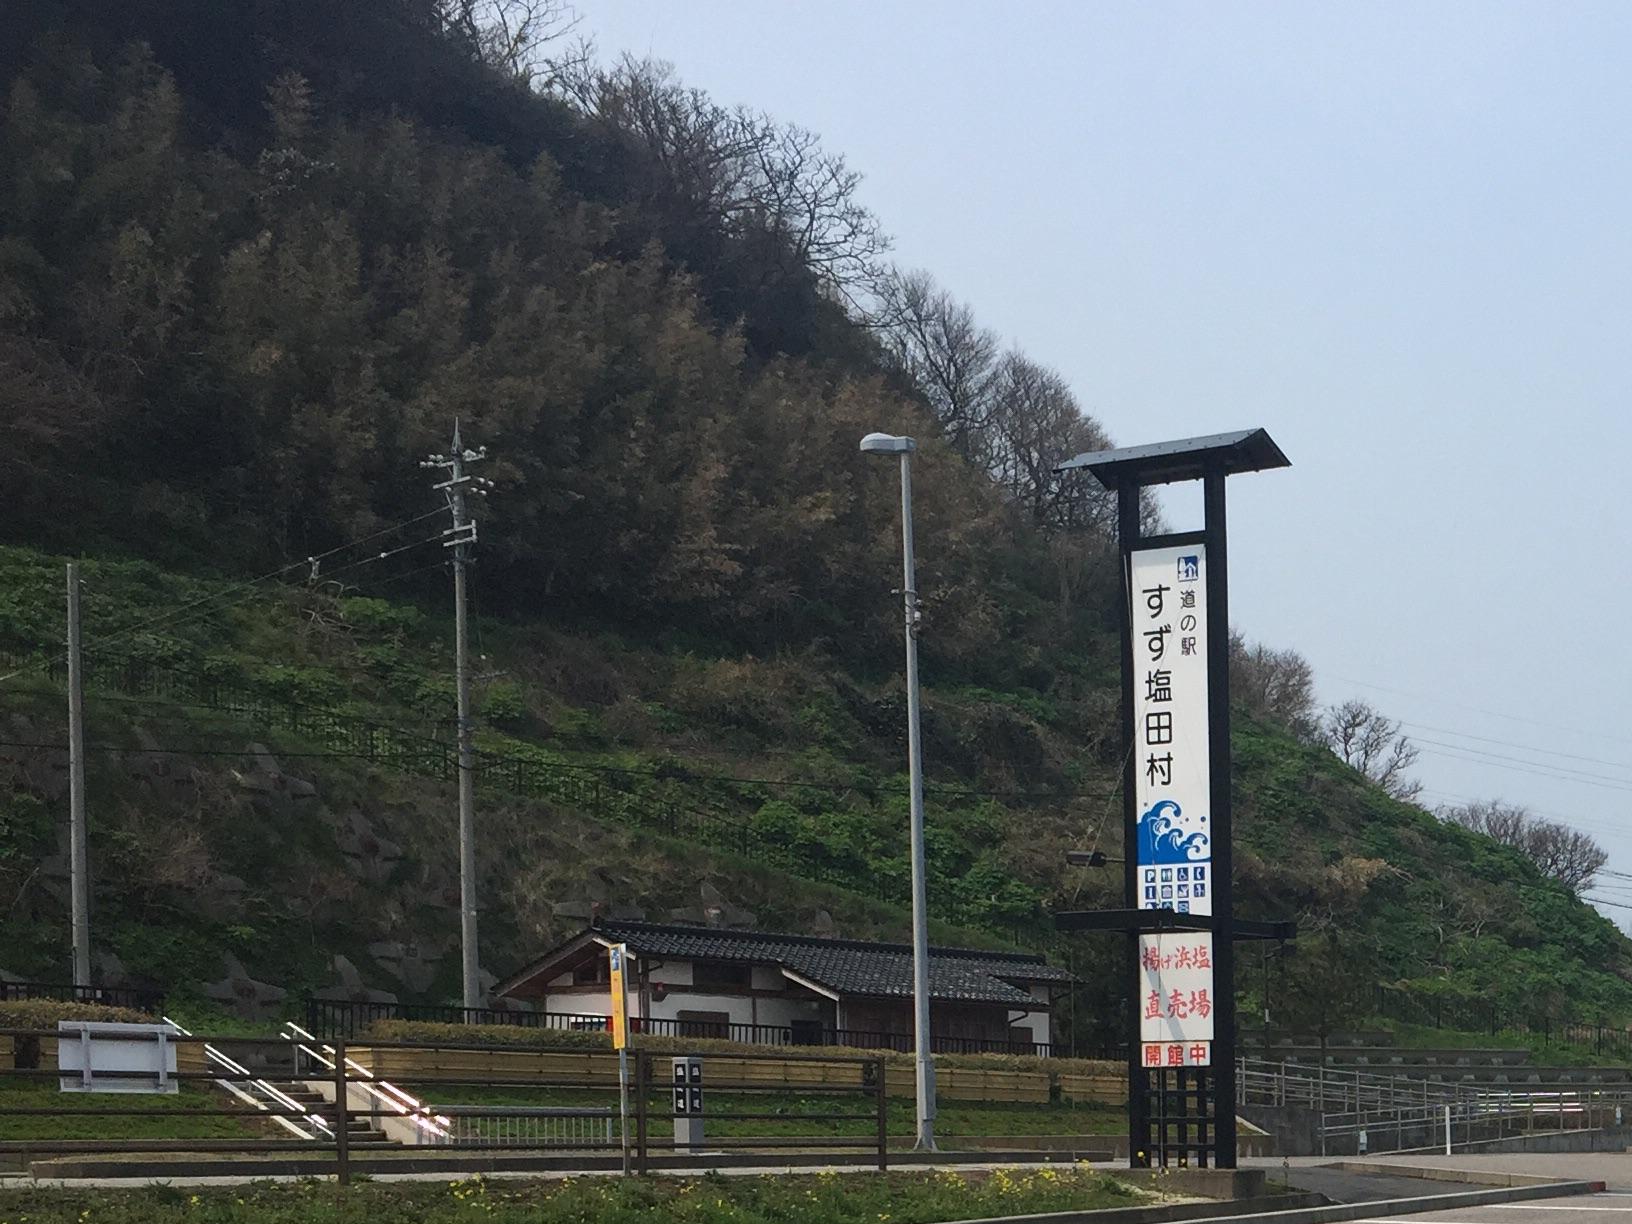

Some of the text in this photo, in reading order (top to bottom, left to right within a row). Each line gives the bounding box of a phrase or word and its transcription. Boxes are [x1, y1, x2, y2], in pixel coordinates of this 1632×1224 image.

[1180, 590, 1197, 656] 道の駅
[1142, 584, 1174, 787] すず塩田村
[1142, 946, 1211, 971] 揚げ浜塩
[1145, 989, 1211, 1020] 直売場
[1145, 1044, 1207, 1066] 開館中
